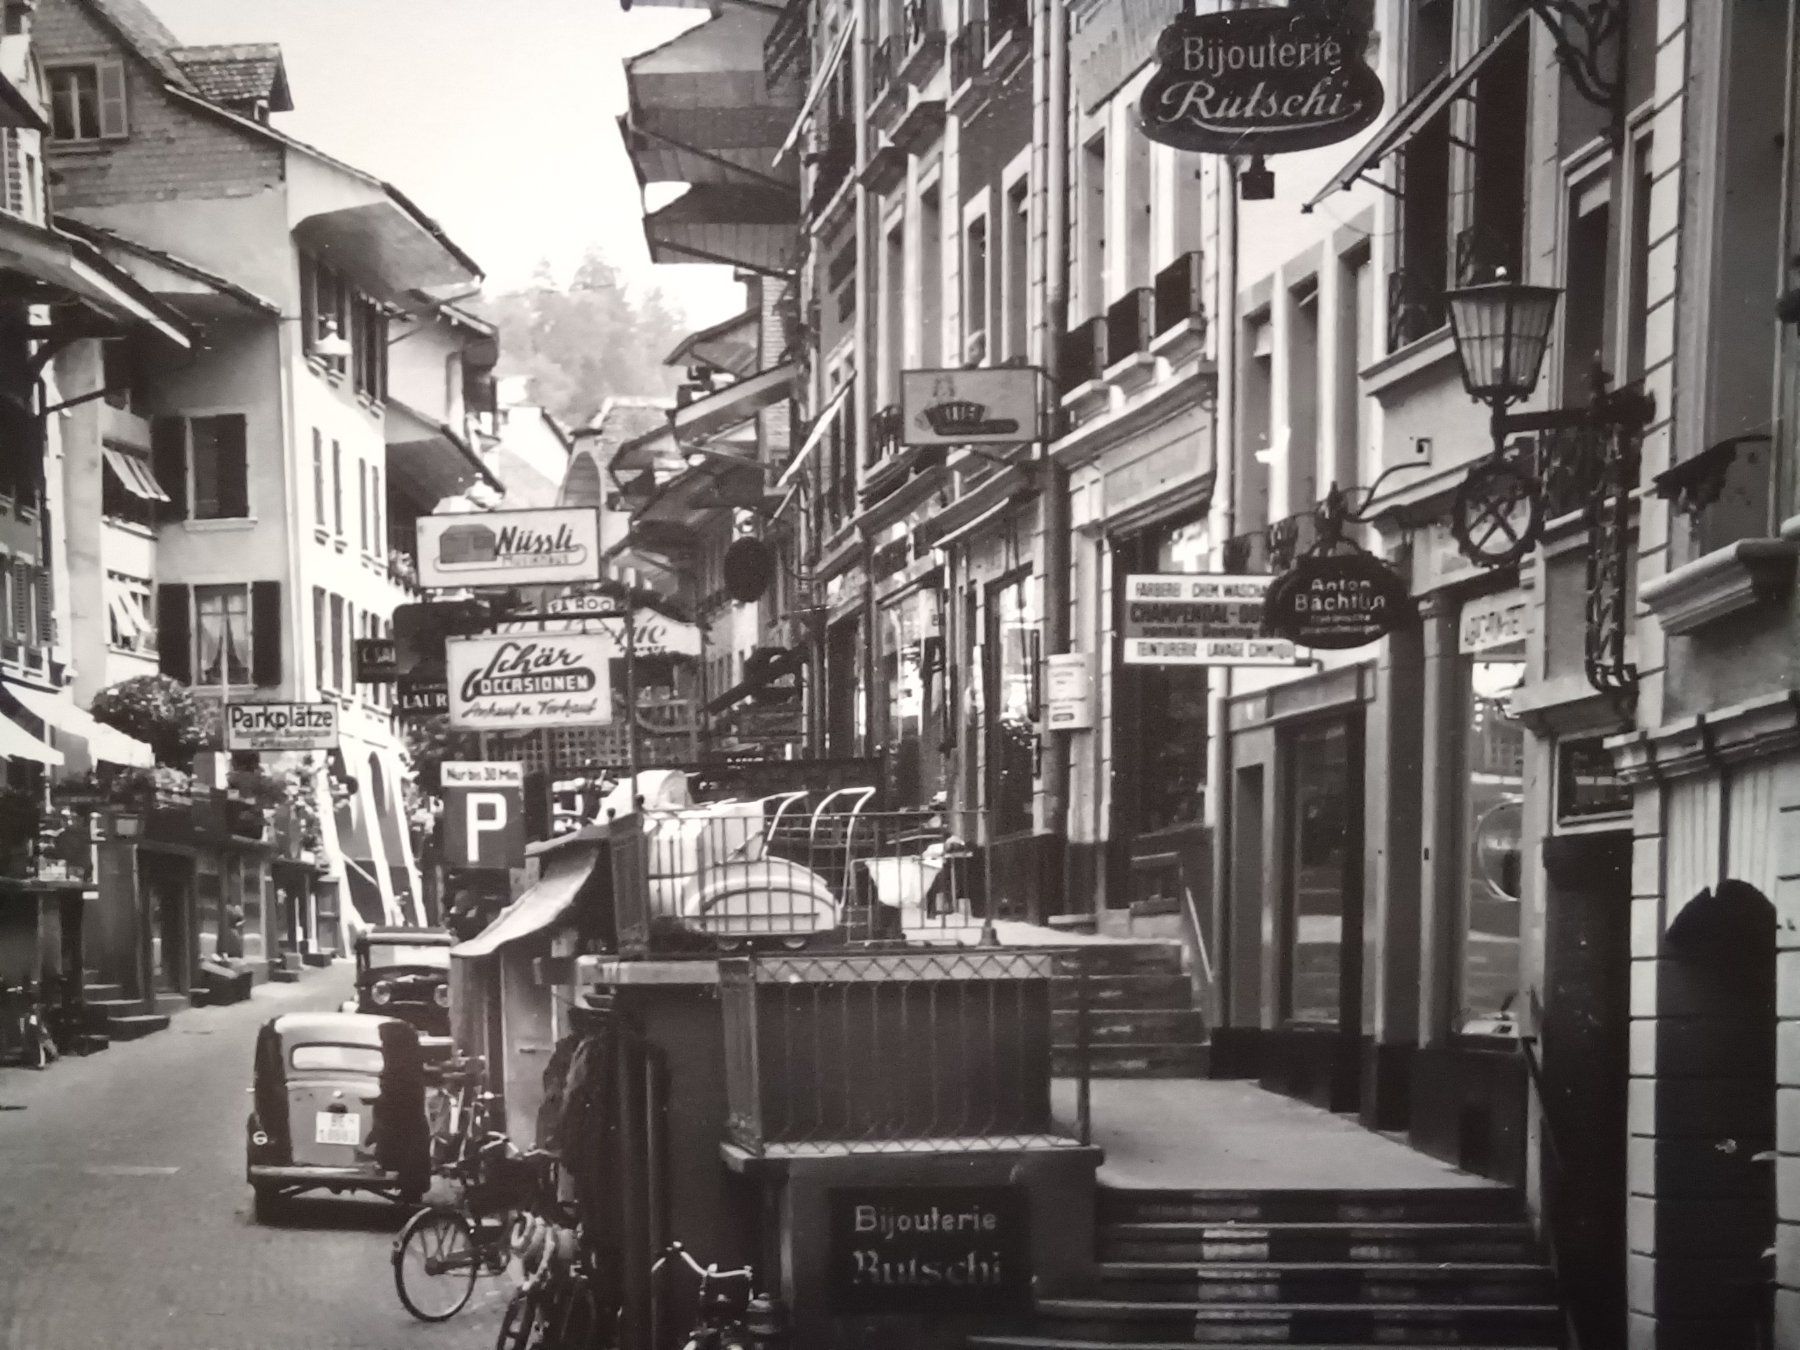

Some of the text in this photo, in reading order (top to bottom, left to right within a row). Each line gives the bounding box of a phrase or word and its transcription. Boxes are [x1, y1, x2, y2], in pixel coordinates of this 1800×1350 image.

[1182, 34, 1342, 77] Bijouterie
[496, 523, 573, 555] Nüssli
[1312, 578, 1371, 591] Anton
[471, 642, 584, 689] Schär
[480, 674, 588, 695] OCCASIONEN
[231, 705, 333, 730] Parkplätze
[466, 792, 508, 863] P
[855, 1204, 997, 1240] Bijouterie
